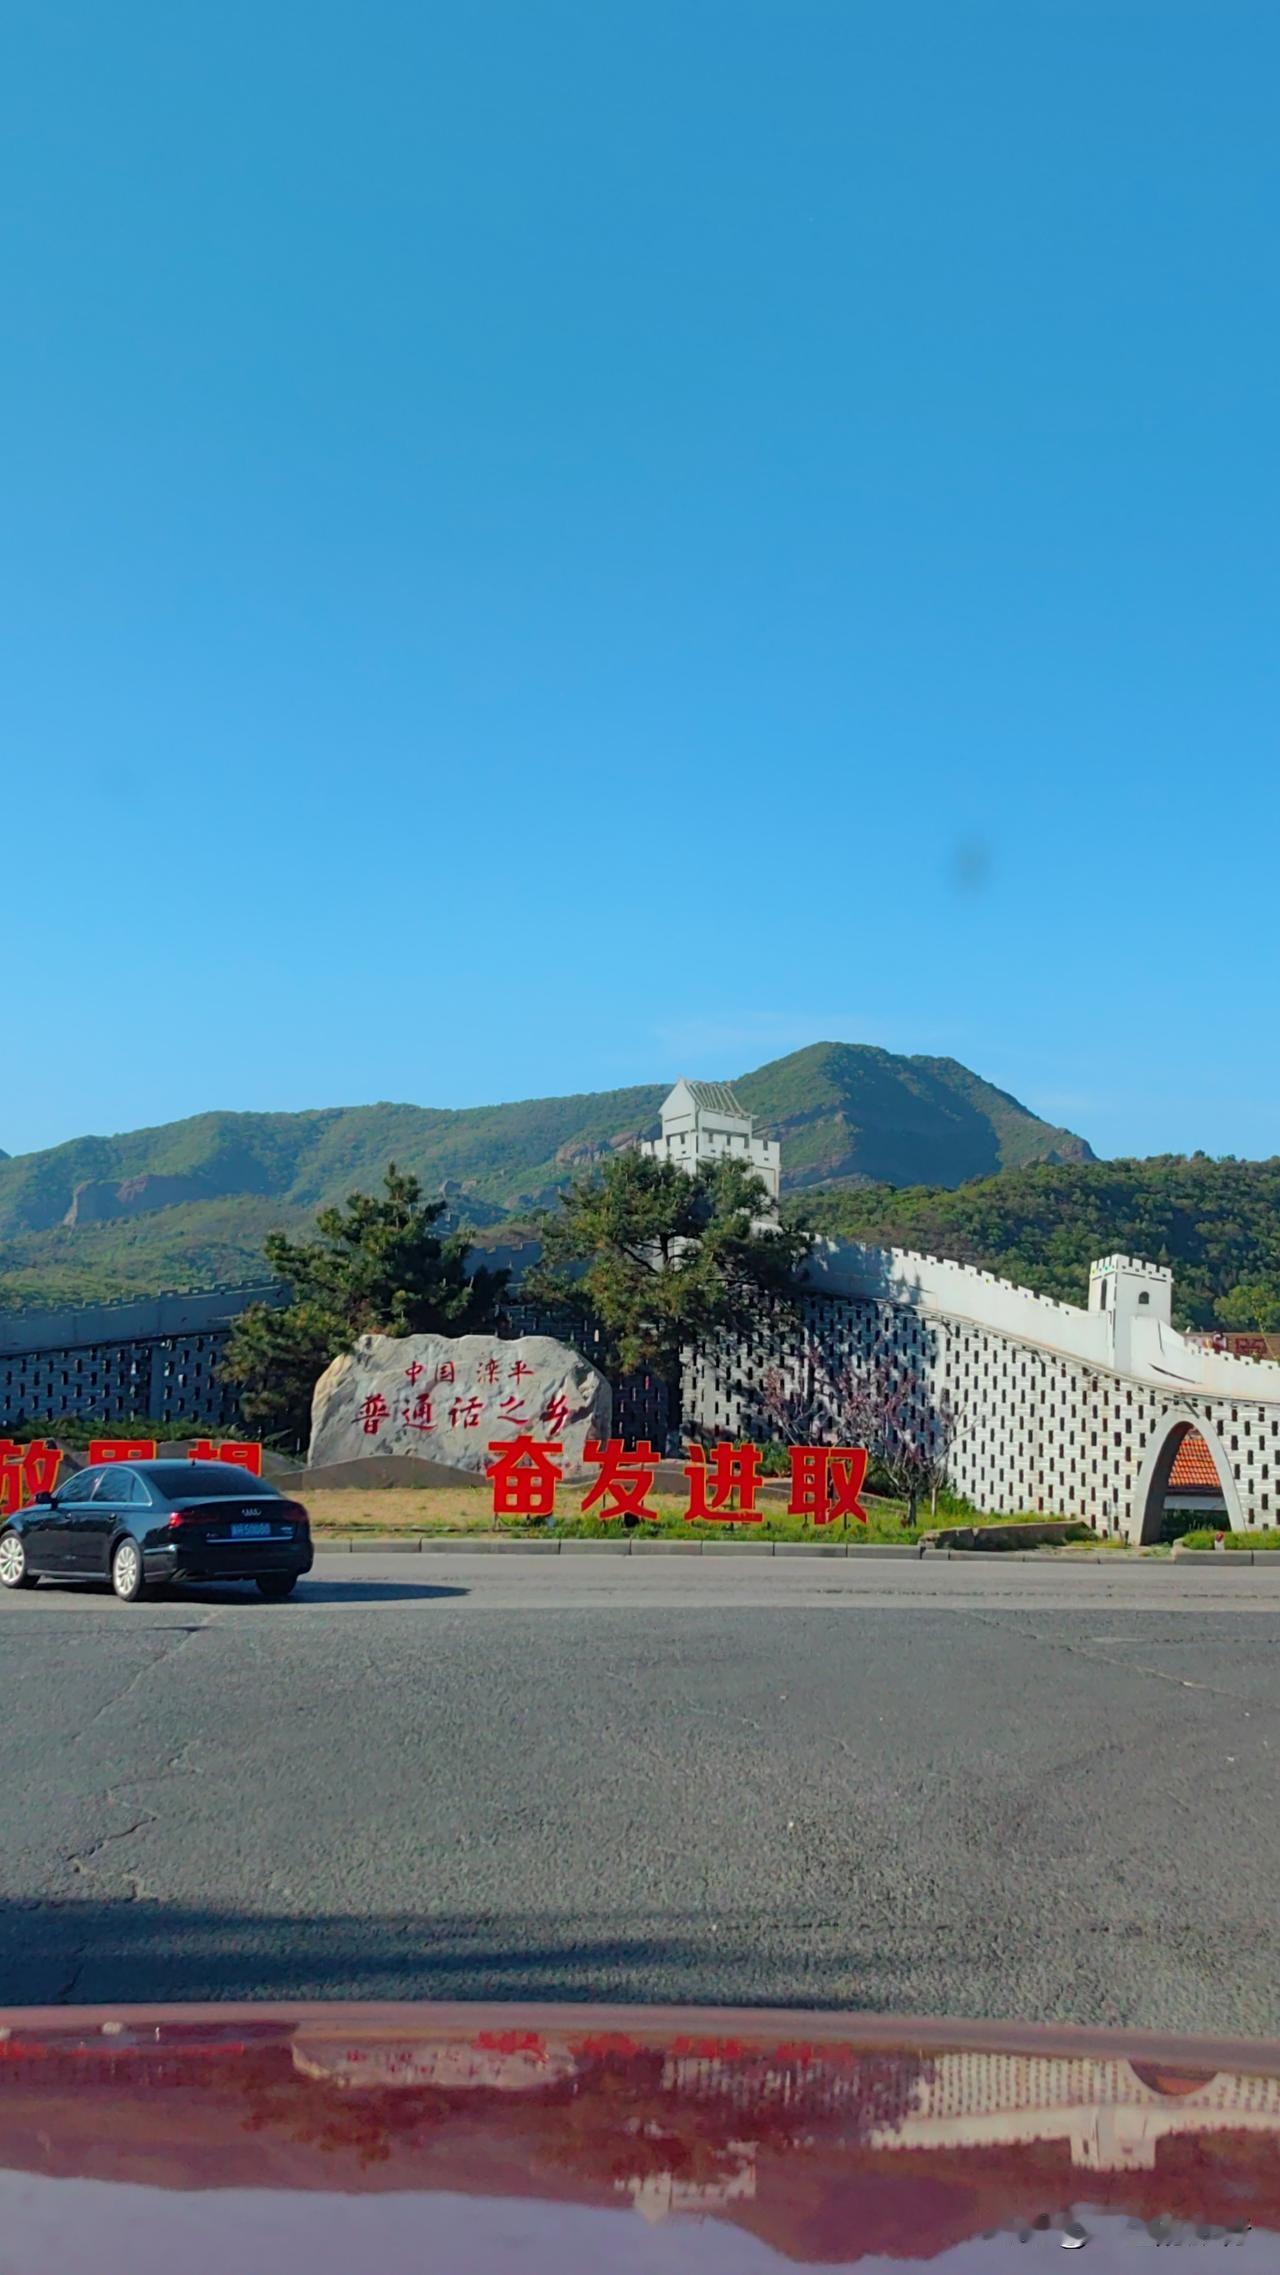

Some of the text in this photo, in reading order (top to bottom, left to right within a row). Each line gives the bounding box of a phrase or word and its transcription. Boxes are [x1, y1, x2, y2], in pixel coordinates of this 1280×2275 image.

[351, 1392, 571, 1437] 普通话之乡
[486, 1434, 870, 1526] 奋发进取
